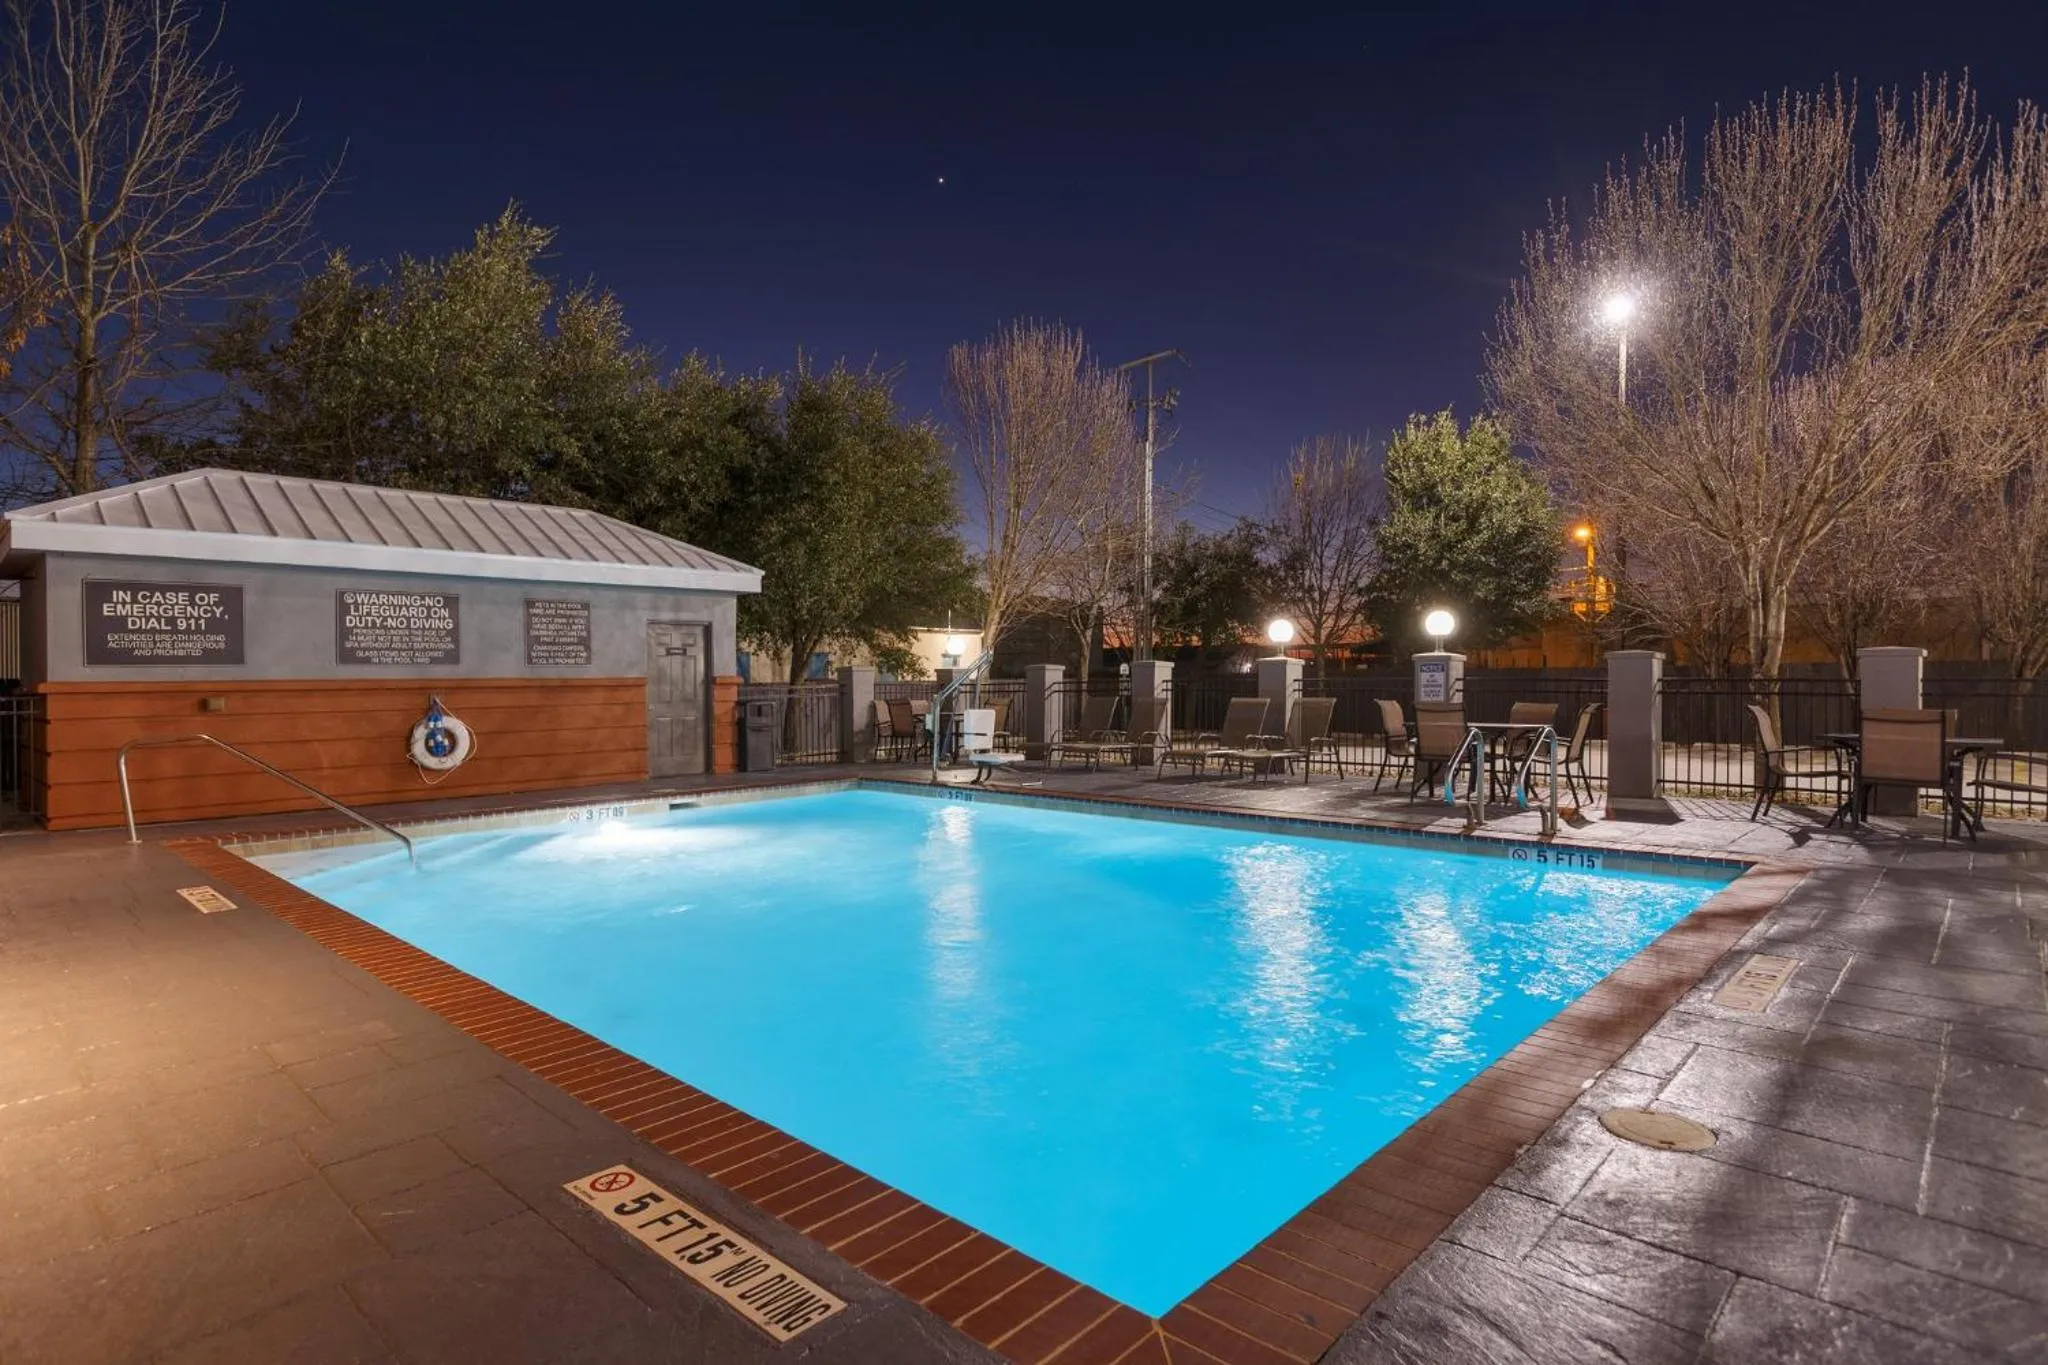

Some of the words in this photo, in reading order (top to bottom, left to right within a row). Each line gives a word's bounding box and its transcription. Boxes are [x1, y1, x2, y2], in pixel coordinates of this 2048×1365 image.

[113, 590, 131, 603] IN
[138, 591, 189, 604] CASE
[195, 593, 219, 605] OF
[103, 603, 229, 620] EMERGENCY,
[350, 605, 427, 618] LIFEGUARD
[430, 607, 449, 618] ON
[128, 617, 171, 630] DIAL
[177, 618, 206, 630] 911
[410, 618, 454, 629] DIVING
[1537, 850, 1548, 863] 5
[1556, 851, 1576, 867] FT
[614, 1192, 664, 1216] 5
[637, 1209, 708, 1242] FT
[710, 1255, 771, 1288] NO
[738, 1274, 831, 1332] DIVING
